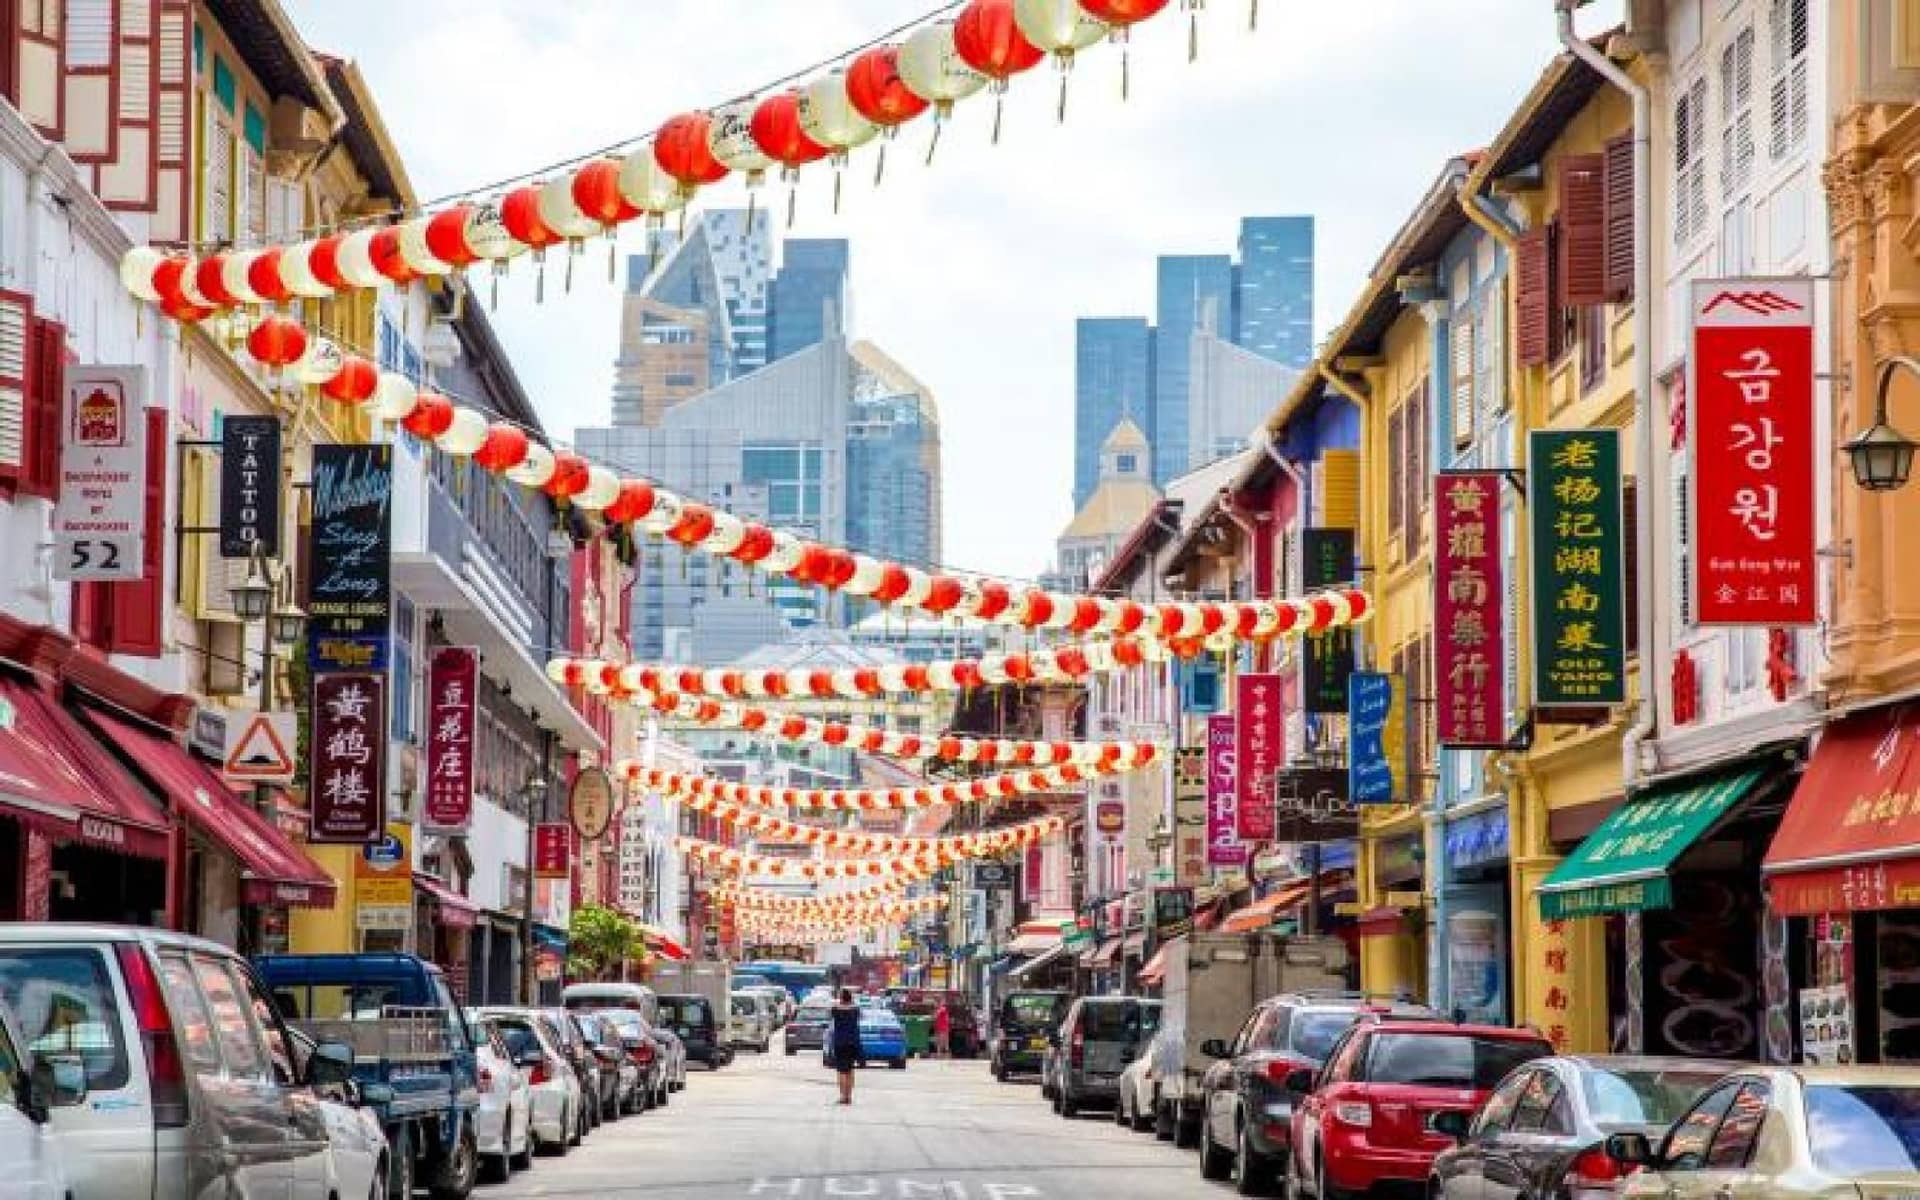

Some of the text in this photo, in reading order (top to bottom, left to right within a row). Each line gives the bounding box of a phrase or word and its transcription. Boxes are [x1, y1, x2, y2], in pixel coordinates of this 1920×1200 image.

[240, 436, 258, 541] TATTOO
[1723, 348, 1784, 541] 금강원
[70, 540, 120, 569] 52
